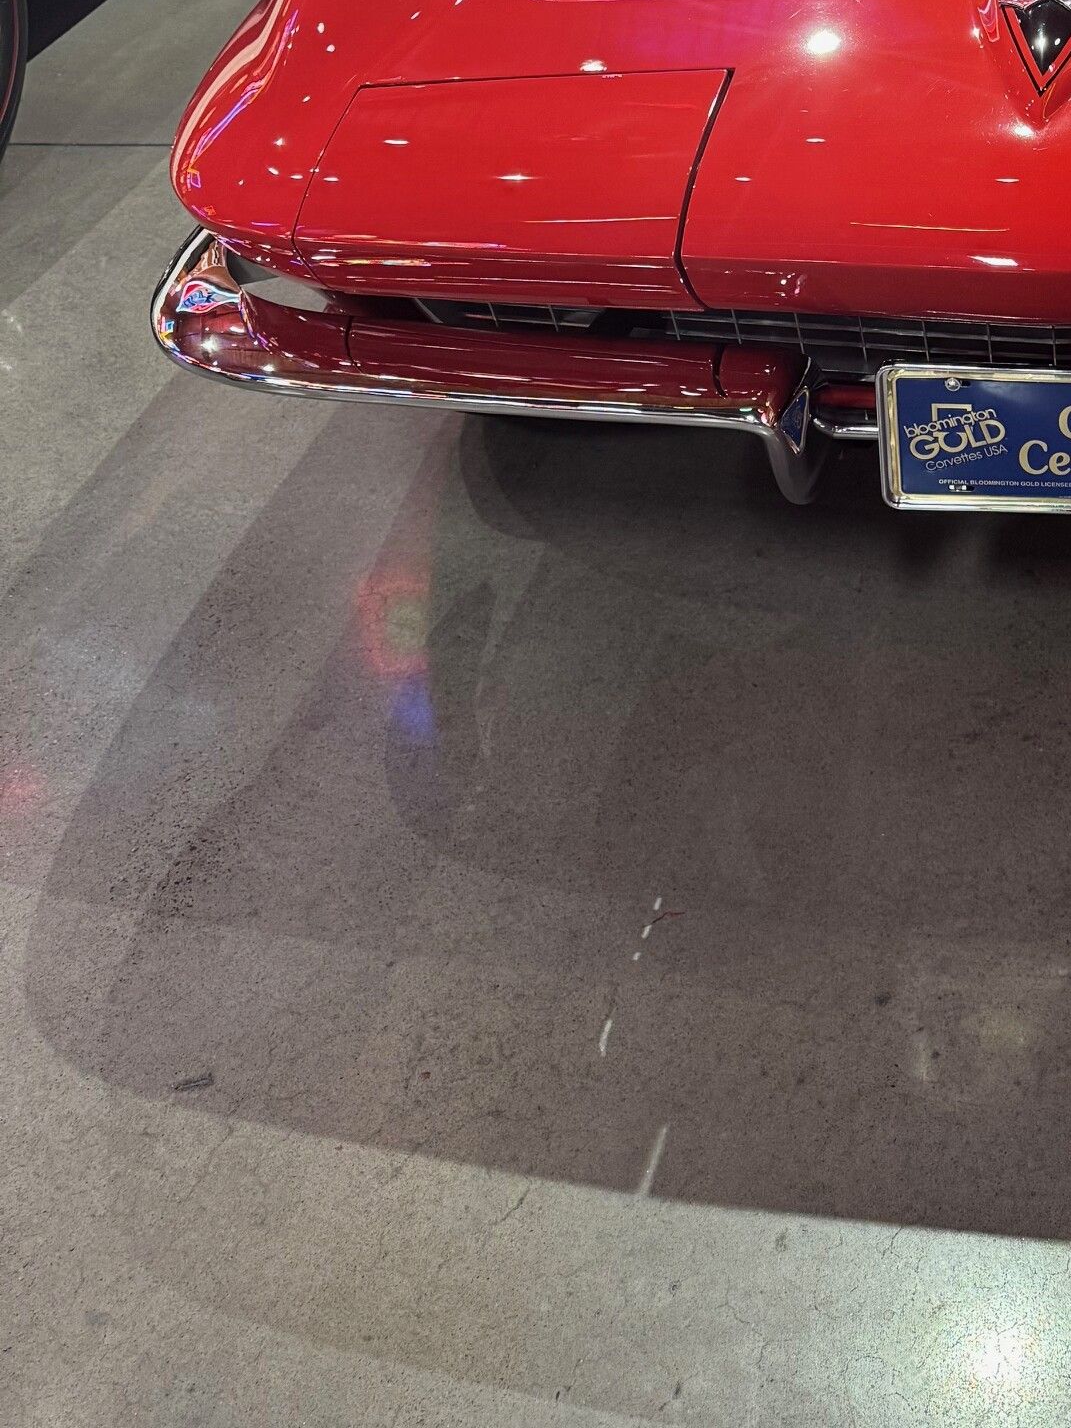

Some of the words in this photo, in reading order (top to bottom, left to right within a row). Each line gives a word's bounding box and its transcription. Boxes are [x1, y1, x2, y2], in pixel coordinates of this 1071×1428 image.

[903, 407, 998, 438] bloomington
[925, 451, 983, 471] Corvettes
[986, 444, 1009, 458] USA
[970, 479, 1019, 487] BLOOMINGTON
